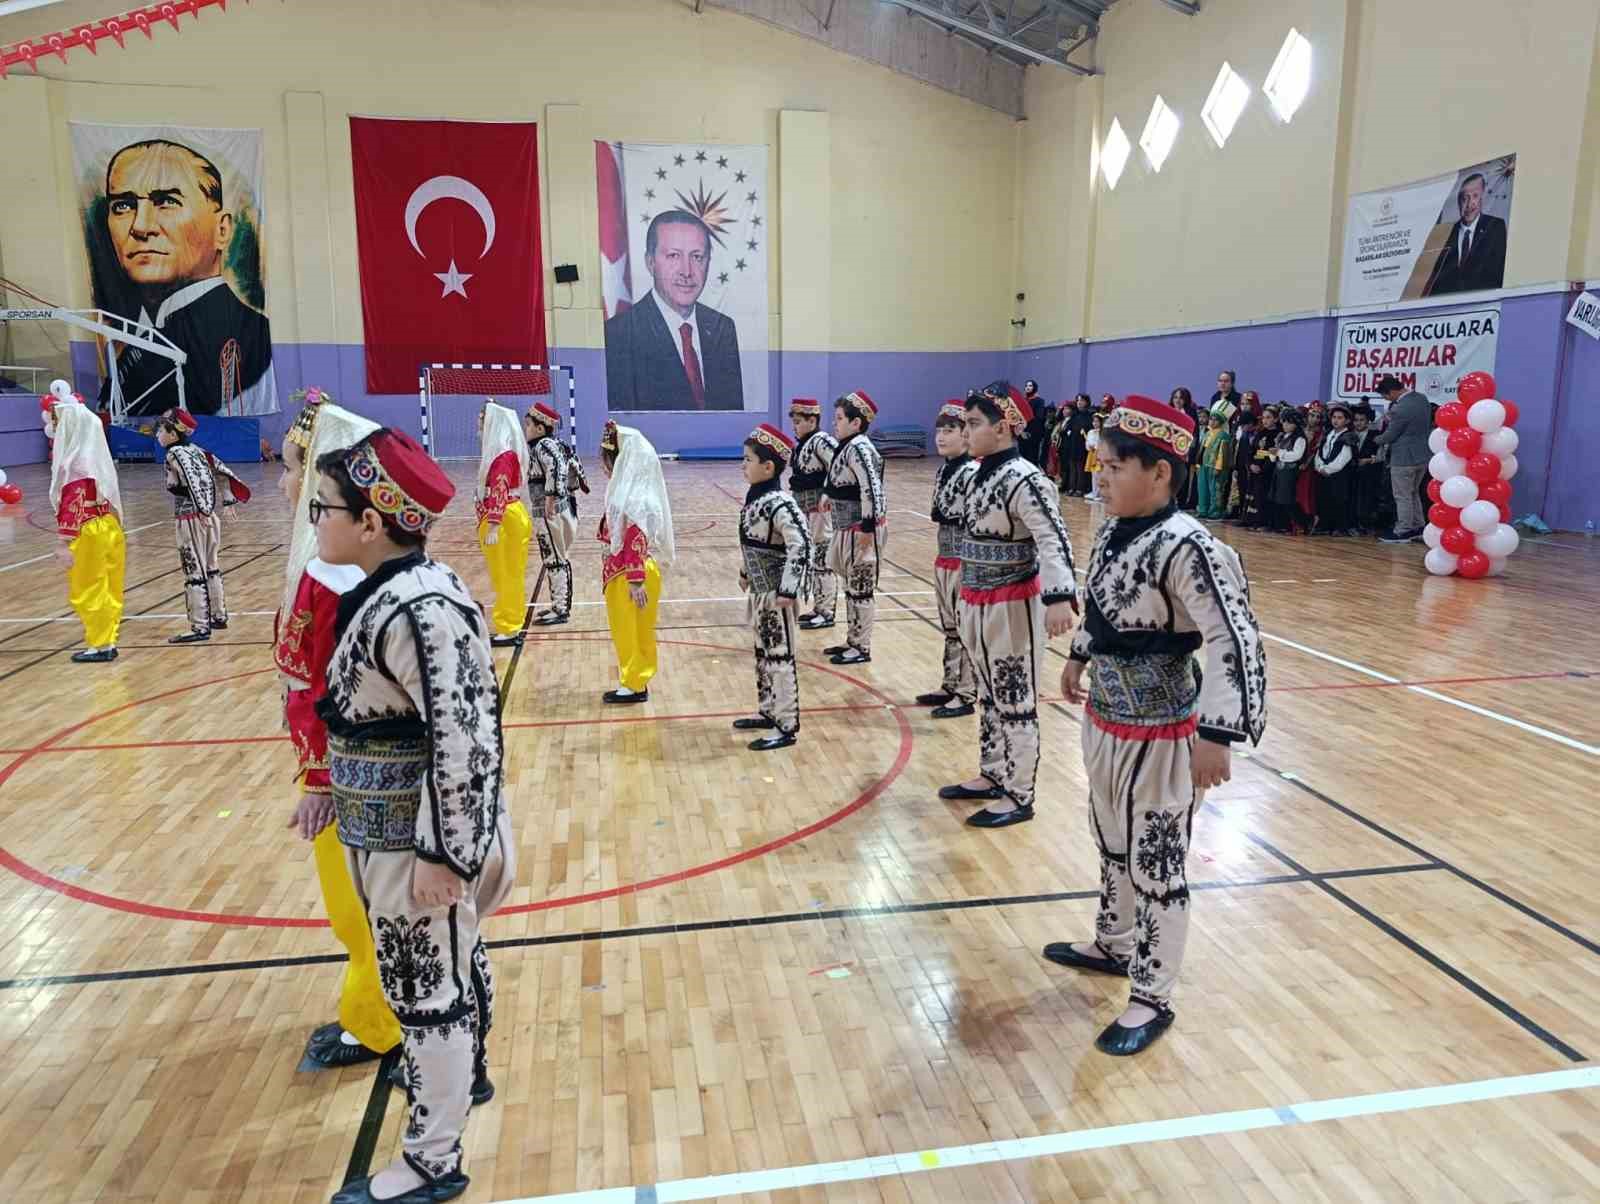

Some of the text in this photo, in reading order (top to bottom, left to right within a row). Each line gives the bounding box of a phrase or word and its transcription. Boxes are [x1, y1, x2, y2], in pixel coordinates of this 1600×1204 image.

[7, 310, 52, 319] SPORSAN
[1347, 318, 1494, 344] TÜM SPORCULARA
[1346, 344, 1457, 371] BAŞARILAR
